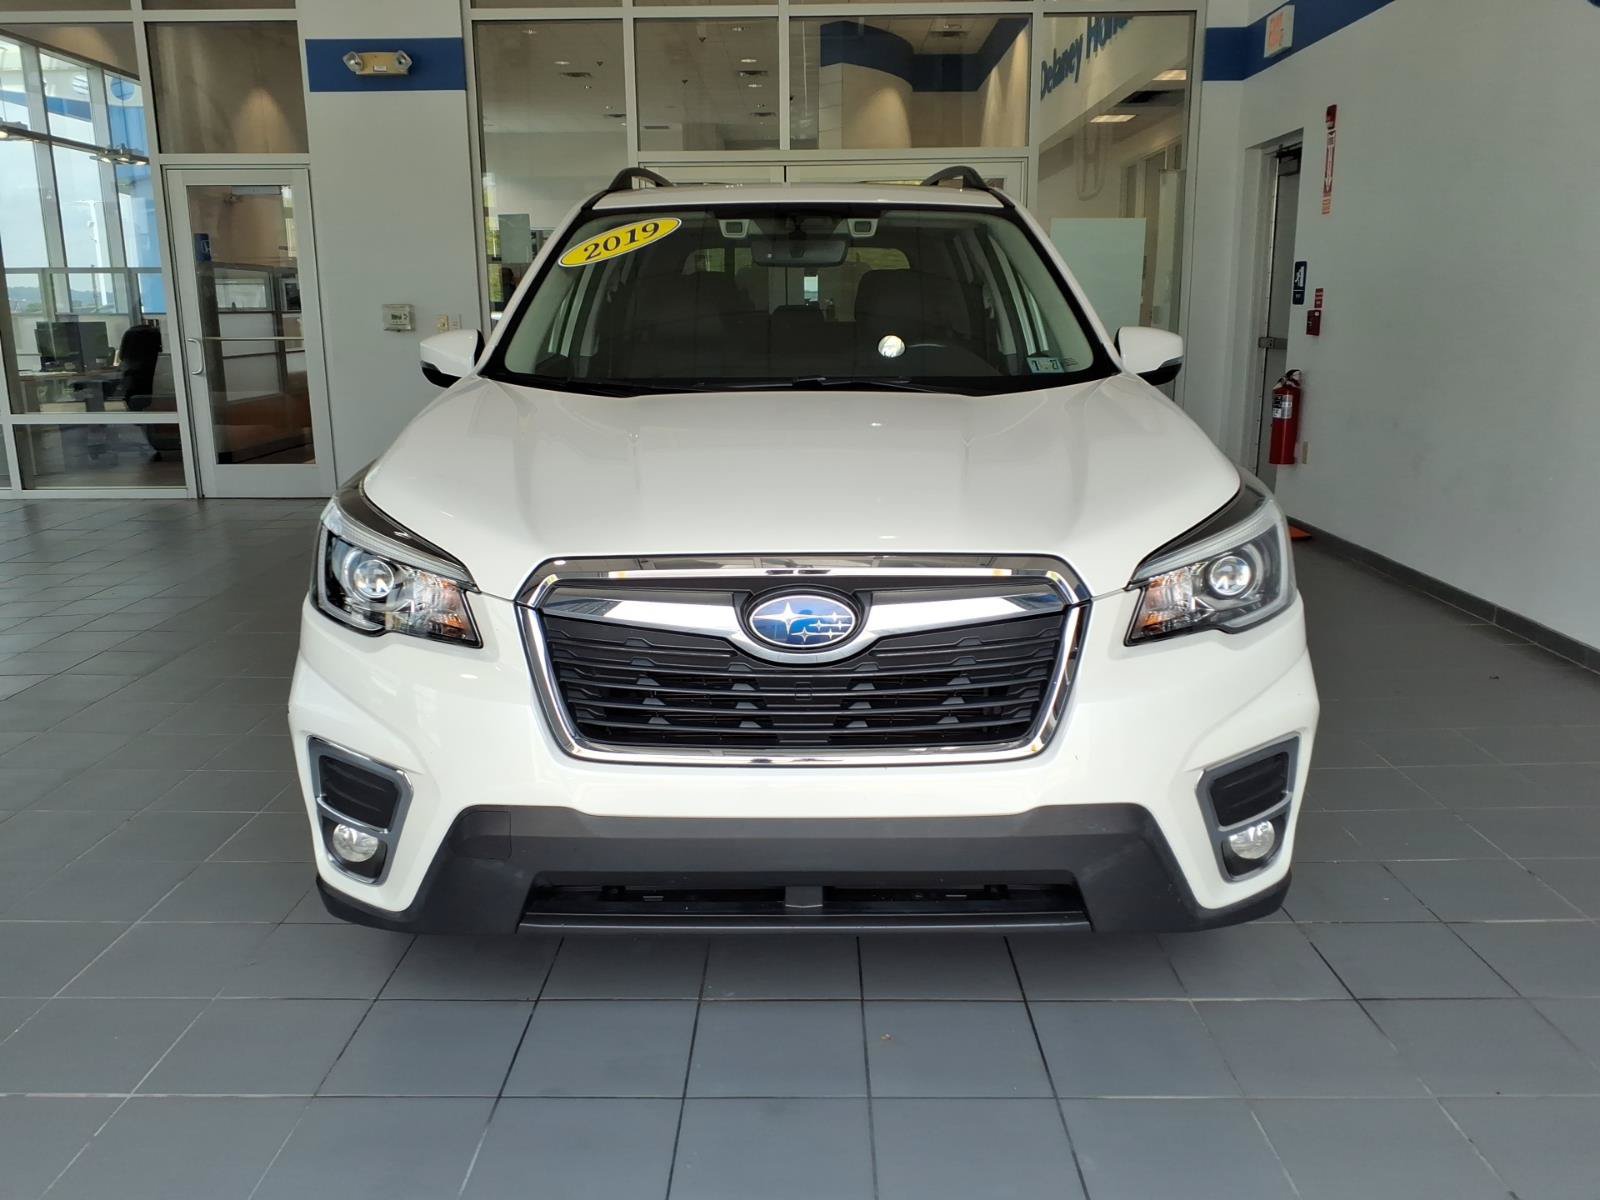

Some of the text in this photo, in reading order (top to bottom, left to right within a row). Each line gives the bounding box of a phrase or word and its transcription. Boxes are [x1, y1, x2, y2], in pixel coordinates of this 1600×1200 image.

[1040, 16, 1133, 100] Delaney Hon
[583, 222, 660, 261] 2019
